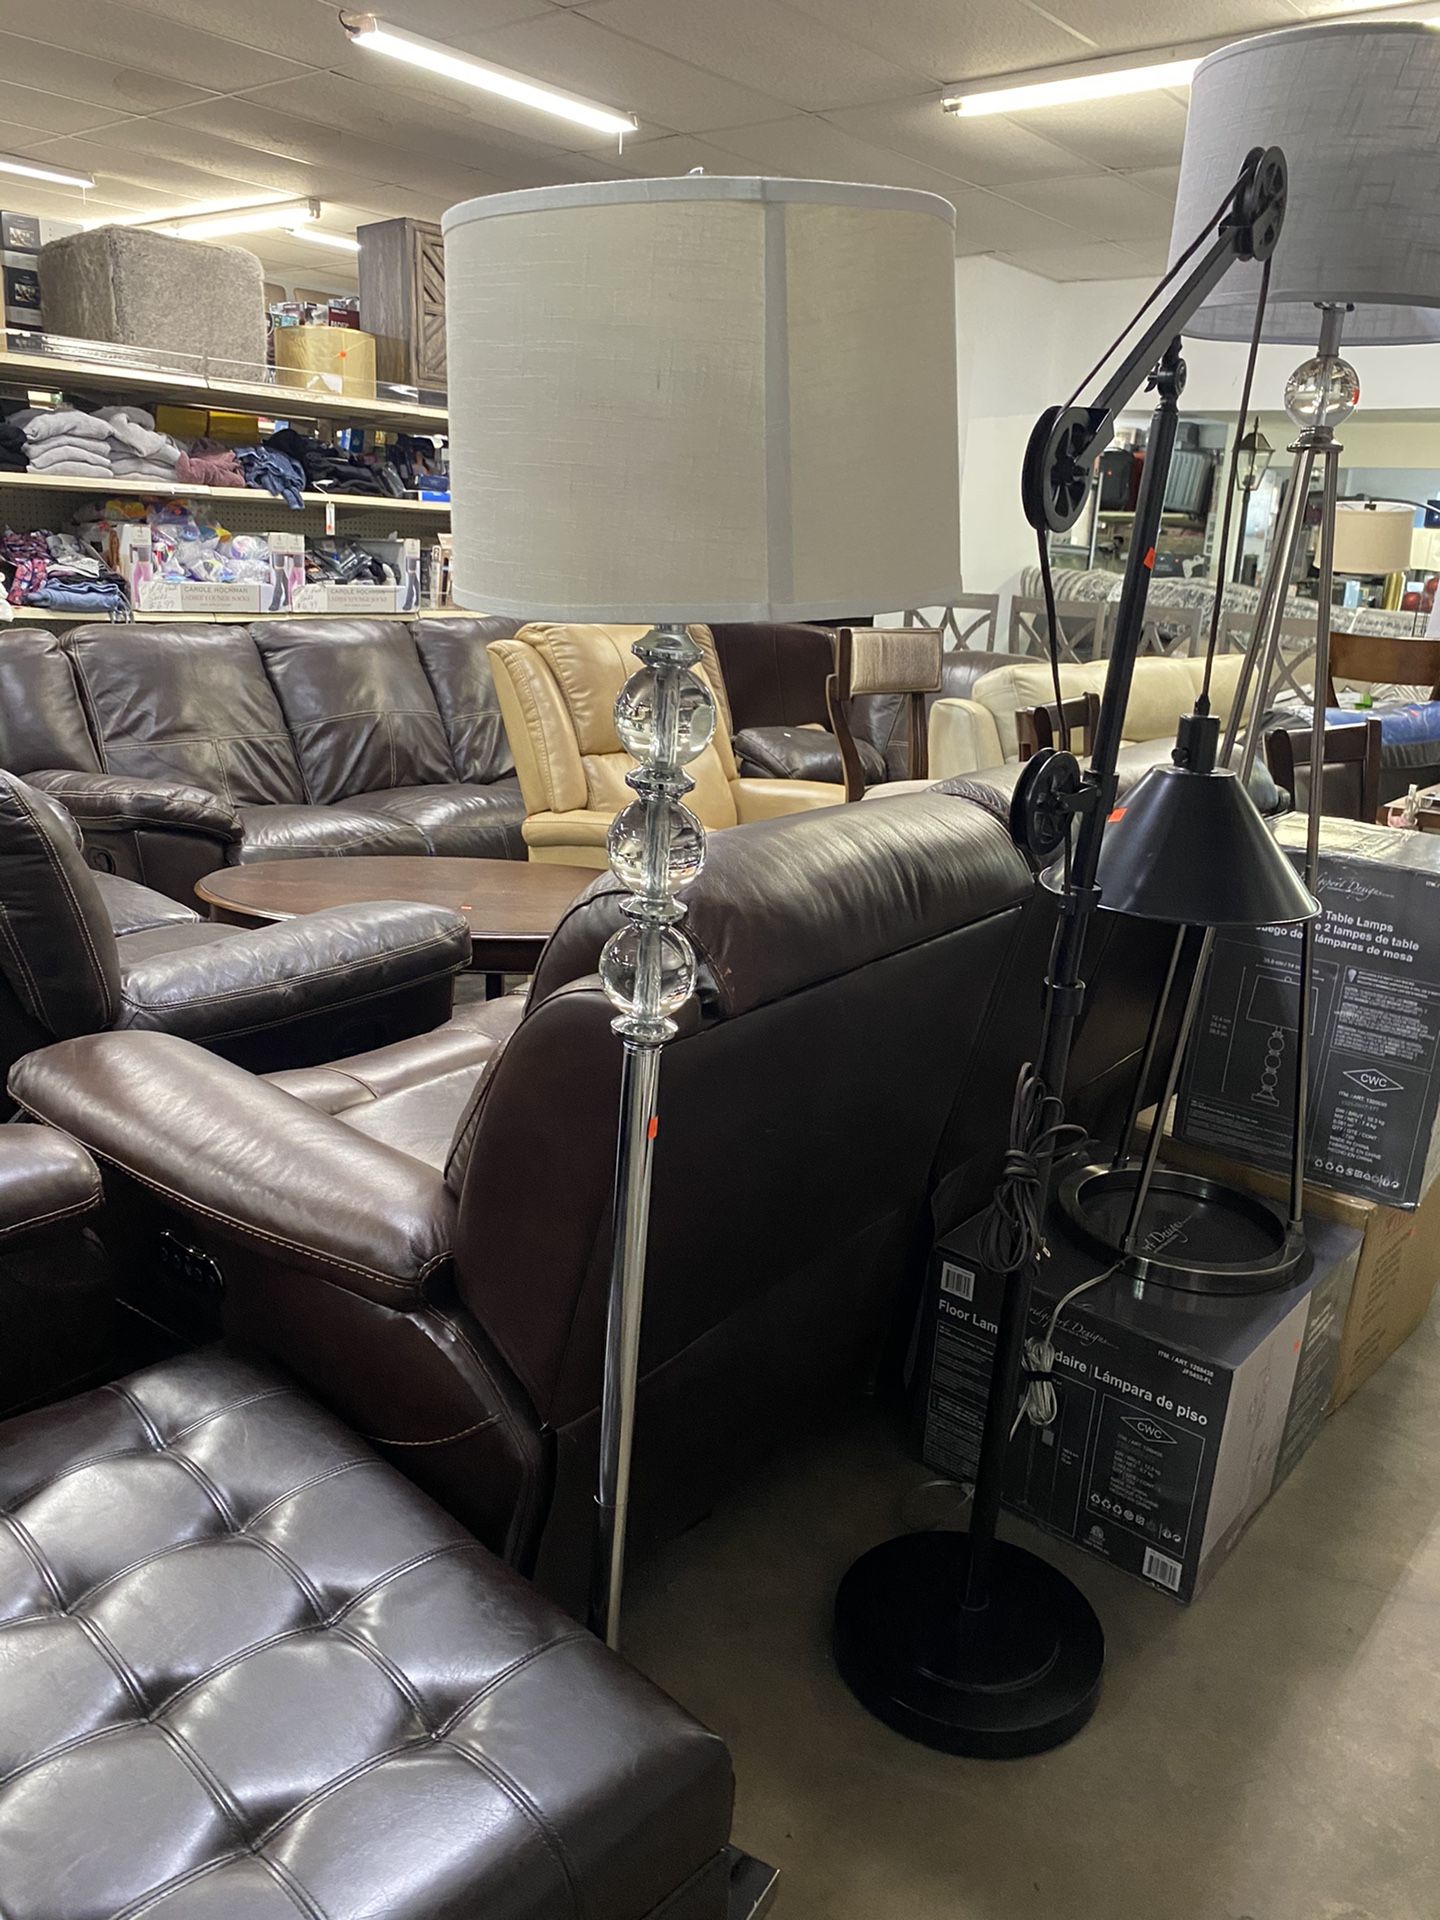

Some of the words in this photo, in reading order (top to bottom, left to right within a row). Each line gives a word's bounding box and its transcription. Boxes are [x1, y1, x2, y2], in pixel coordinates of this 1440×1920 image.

[1326, 910, 1354, 925] Table
[1356, 916, 1393, 933] Lamps
[1289, 929, 1304, 939] de
[1315, 933, 1364, 952] lámparas
[1366, 945, 1381, 956] de
[1383, 950, 1414, 963] mesa
[1324, 923, 1332, 933] 2
[1333, 927, 1372, 943] lampes
[1375, 935, 1389, 946] de
[1391, 937, 1420, 951] table
[1360, 1073, 1388, 1089] CWC
[938, 1298, 970, 1322] Floor
[972, 1313, 998, 1335] Lam
[1055, 1351, 1088, 1373] daire
[1094, 1365, 1152, 1402] Lámpara
[1156, 1395, 1173, 1410] de
[1176, 1404, 1208, 1427] piso
[1137, 1421, 1162, 1439] CWC
